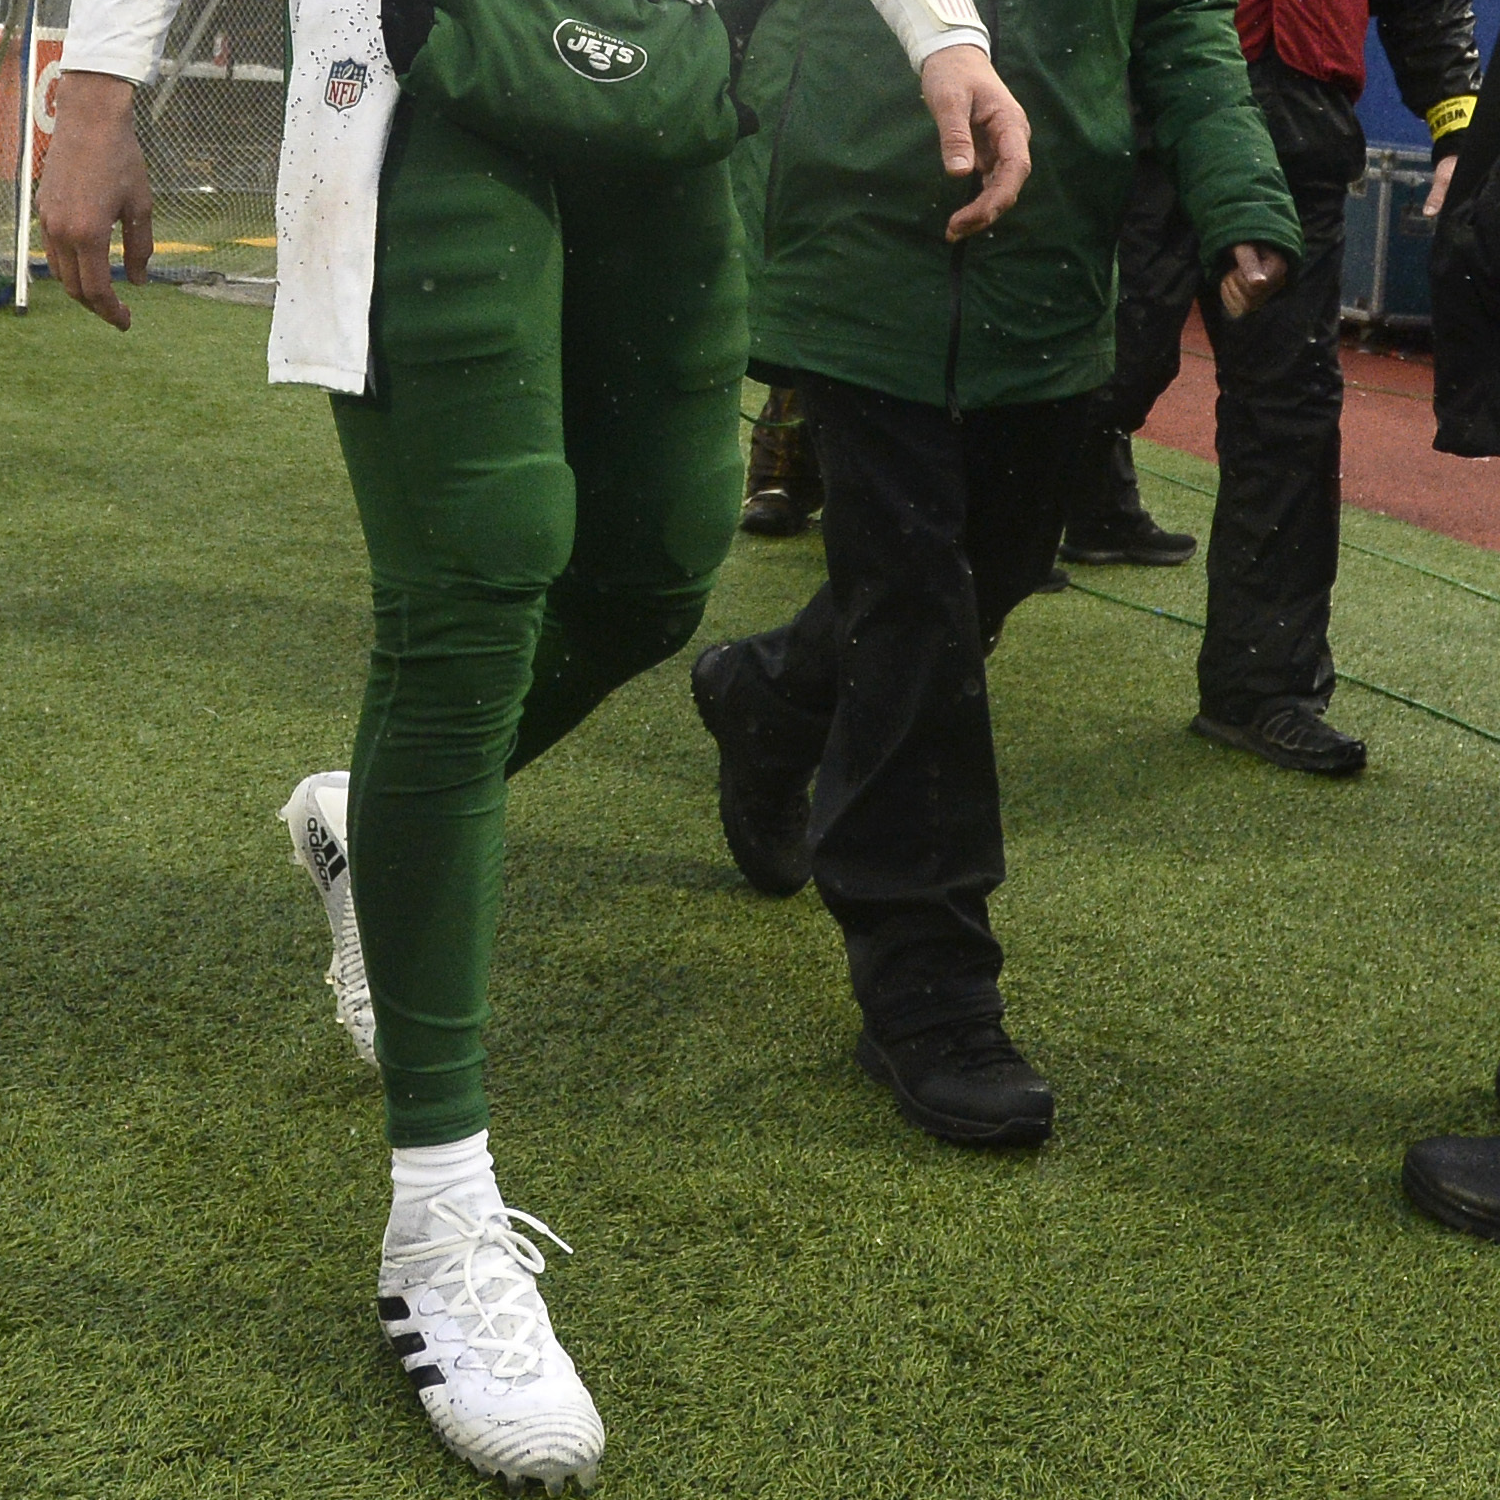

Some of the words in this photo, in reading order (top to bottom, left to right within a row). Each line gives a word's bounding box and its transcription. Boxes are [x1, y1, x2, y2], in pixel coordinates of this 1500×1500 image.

[574, 25, 597, 37] NEW
[598, 33, 624, 45] YORK
[567, 35, 635, 64] JETS
[328, 80, 358, 106] NFL
[307, 816, 331, 892] adidas
